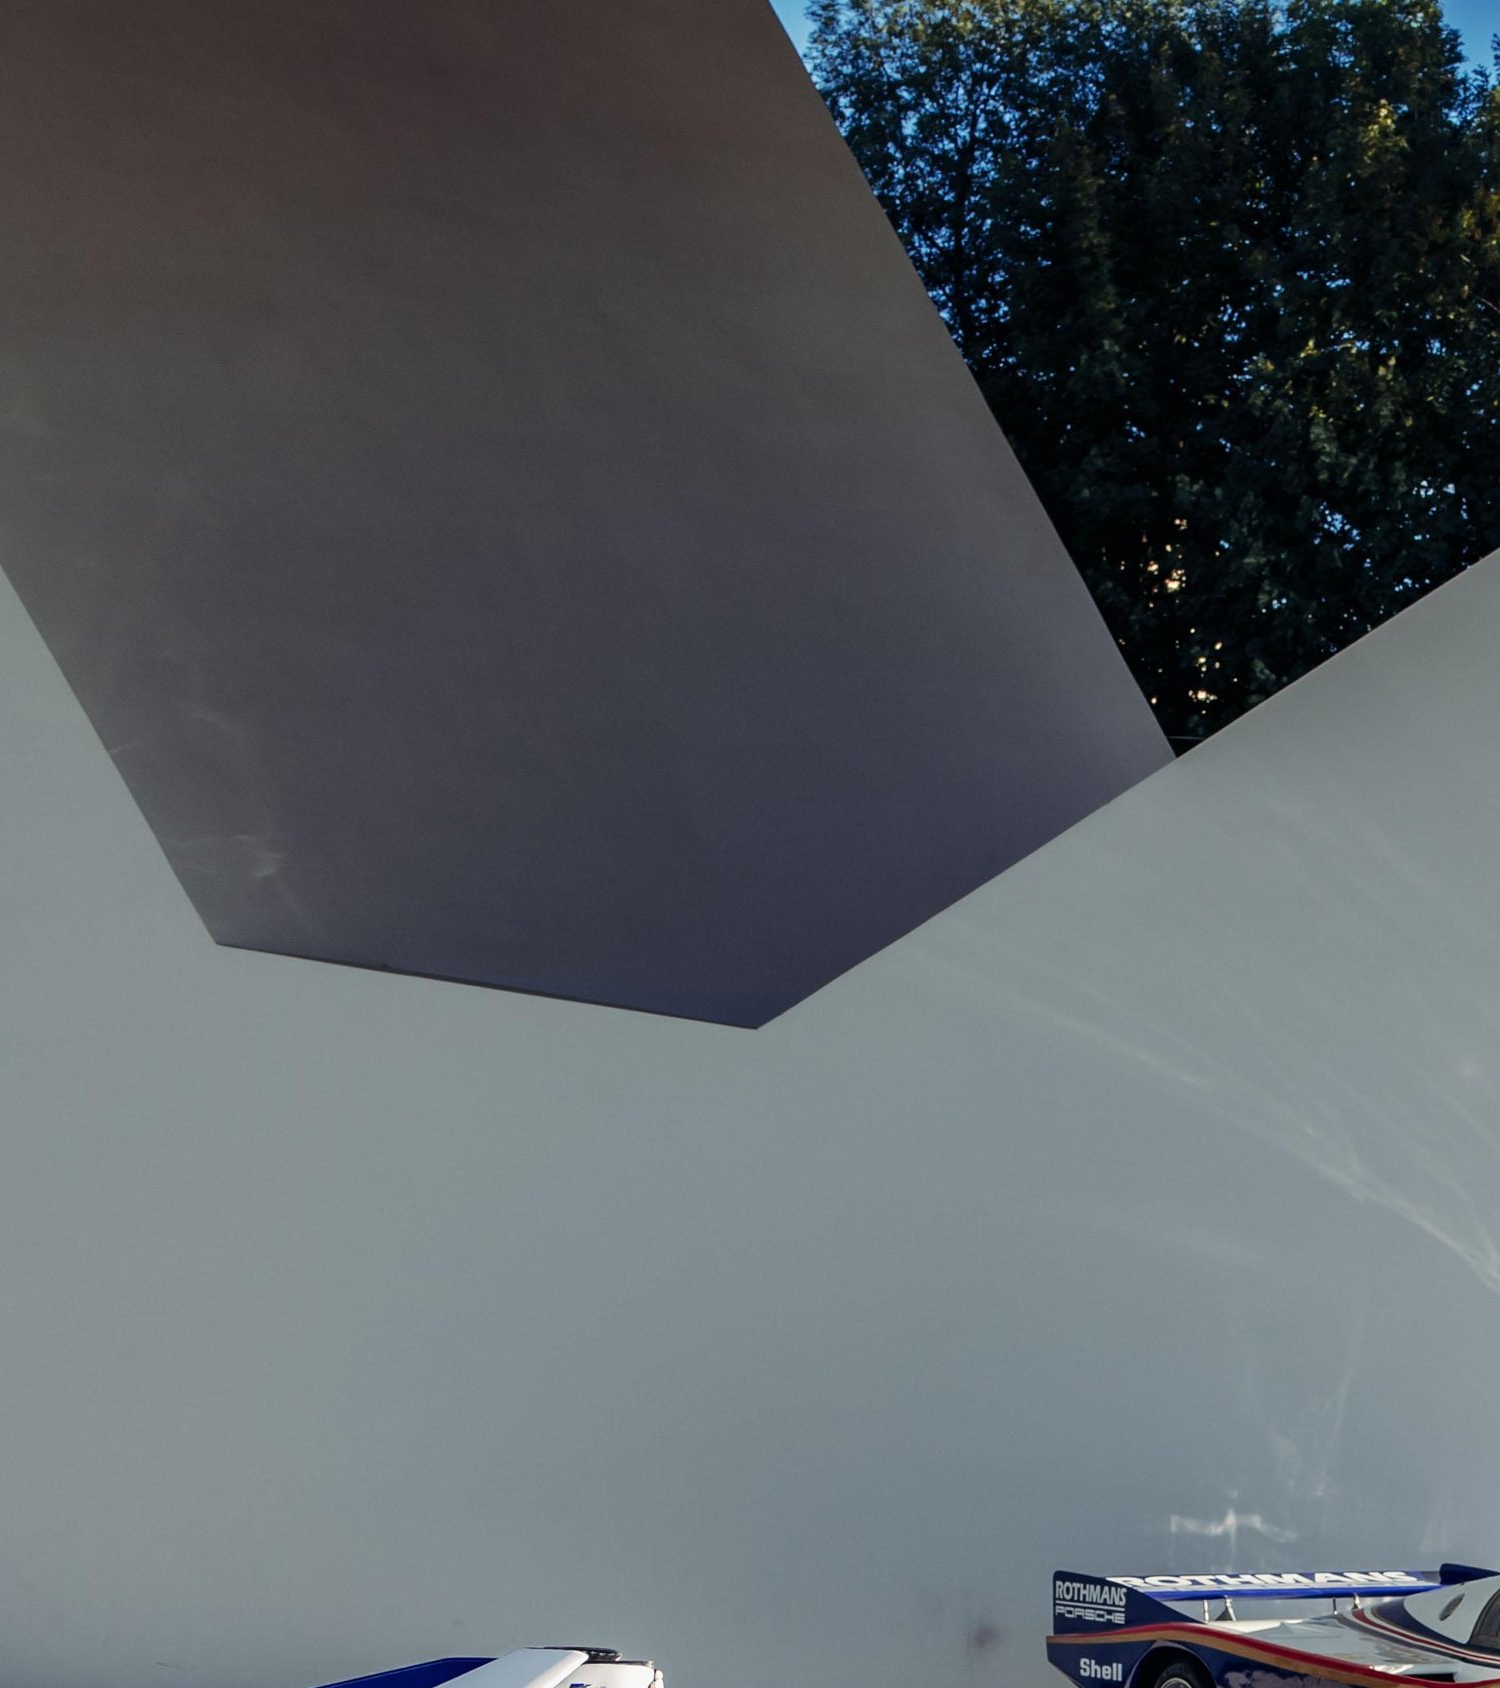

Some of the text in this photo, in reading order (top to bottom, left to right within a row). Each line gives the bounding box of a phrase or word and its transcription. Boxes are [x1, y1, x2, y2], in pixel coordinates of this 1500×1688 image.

[1106, 1571, 1419, 1588] ROTHMANS
[1055, 1581, 1127, 1605] ROTHMANS
[1055, 1605, 1126, 1624] PORSCHE
[1080, 1658, 1123, 1682] Shell
